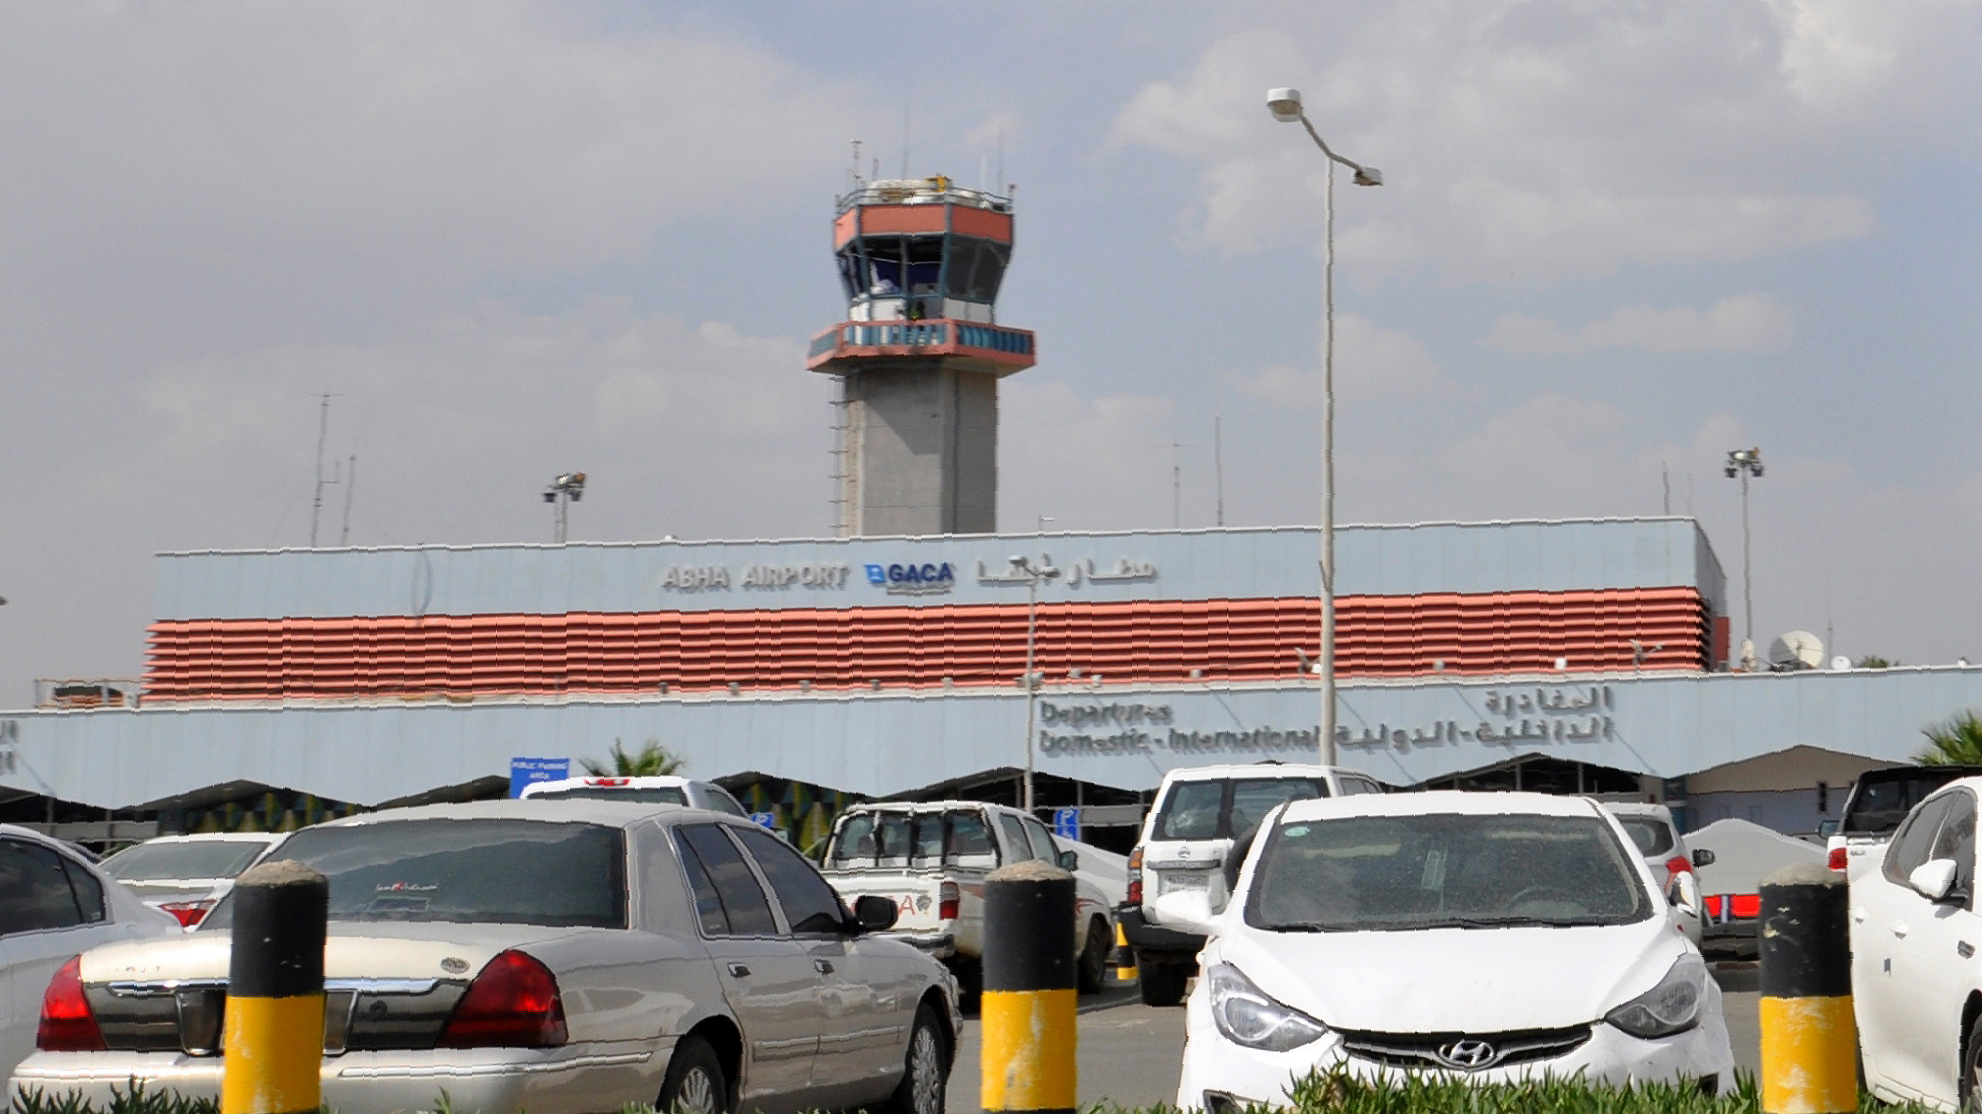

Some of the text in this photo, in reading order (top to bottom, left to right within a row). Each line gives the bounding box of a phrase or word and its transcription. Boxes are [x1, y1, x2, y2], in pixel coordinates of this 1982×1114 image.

[662, 563, 851, 592] ABHA AIRPORT
[887, 562, 955, 583] GACA
[1066, 557, 1157, 586] مطار
[1040, 701, 1173, 728] Departures
[1484, 686, 1613, 717] المغادرة
[1040, 730, 1151, 755] Domestic
[1168, 726, 1321, 753] International
